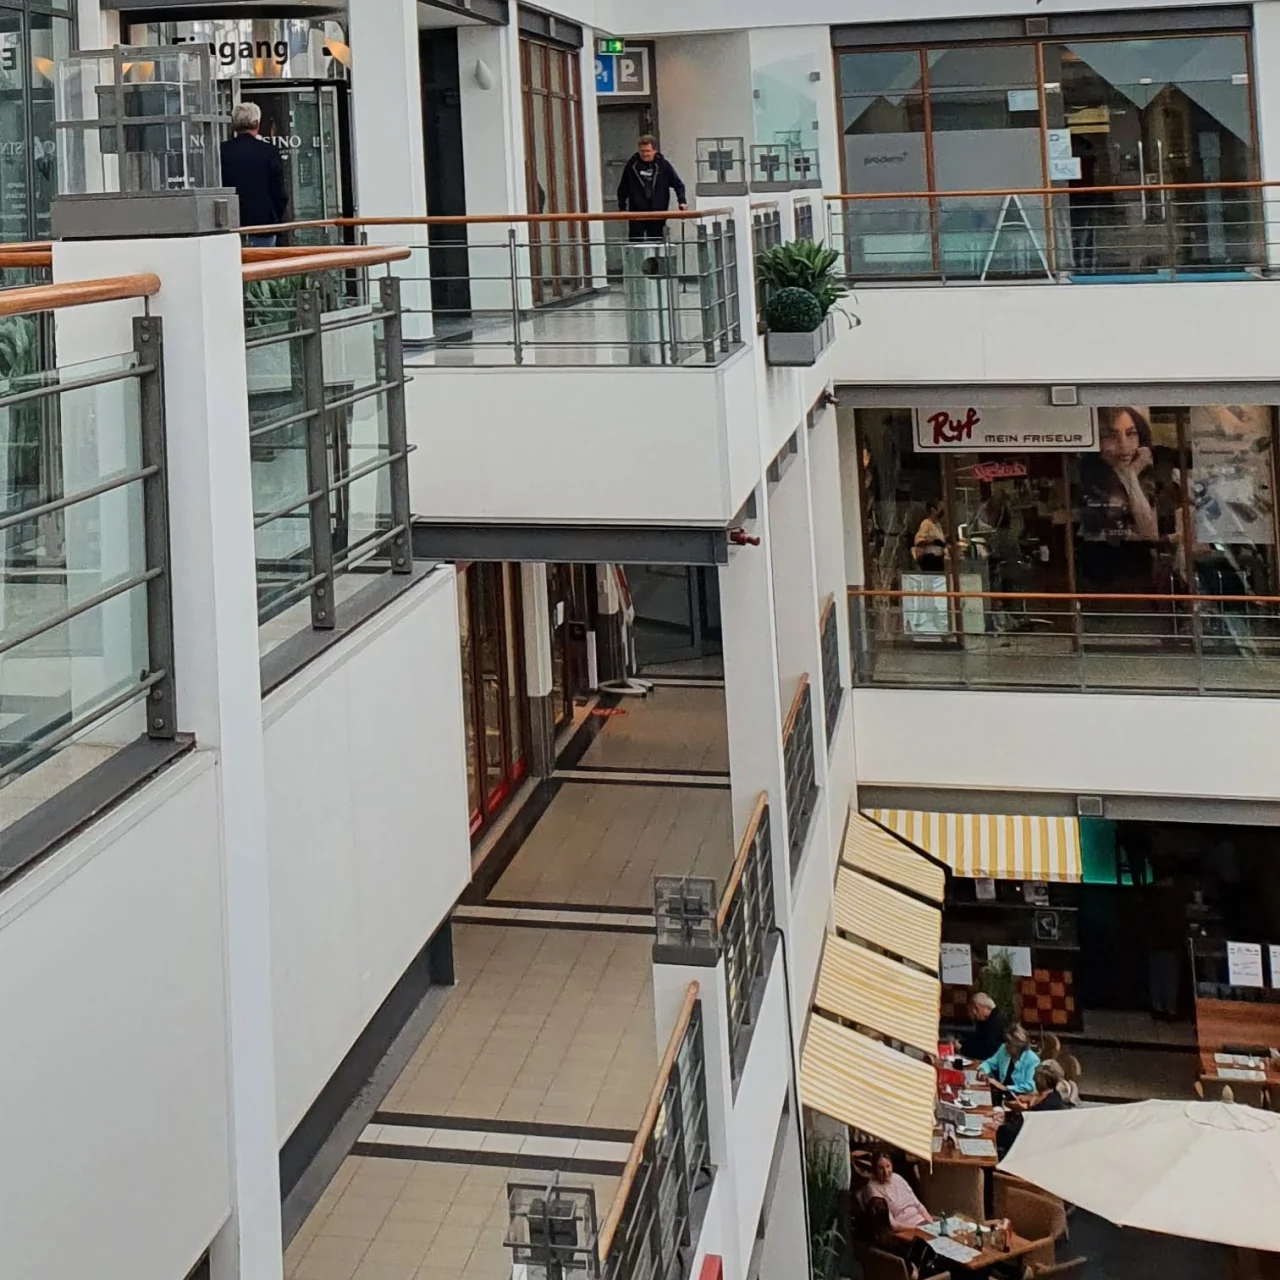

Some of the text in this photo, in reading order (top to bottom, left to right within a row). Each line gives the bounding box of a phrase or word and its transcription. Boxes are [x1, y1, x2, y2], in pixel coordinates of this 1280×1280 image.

[927, 407, 1083, 445] Ryf MEIN FRISEUR
